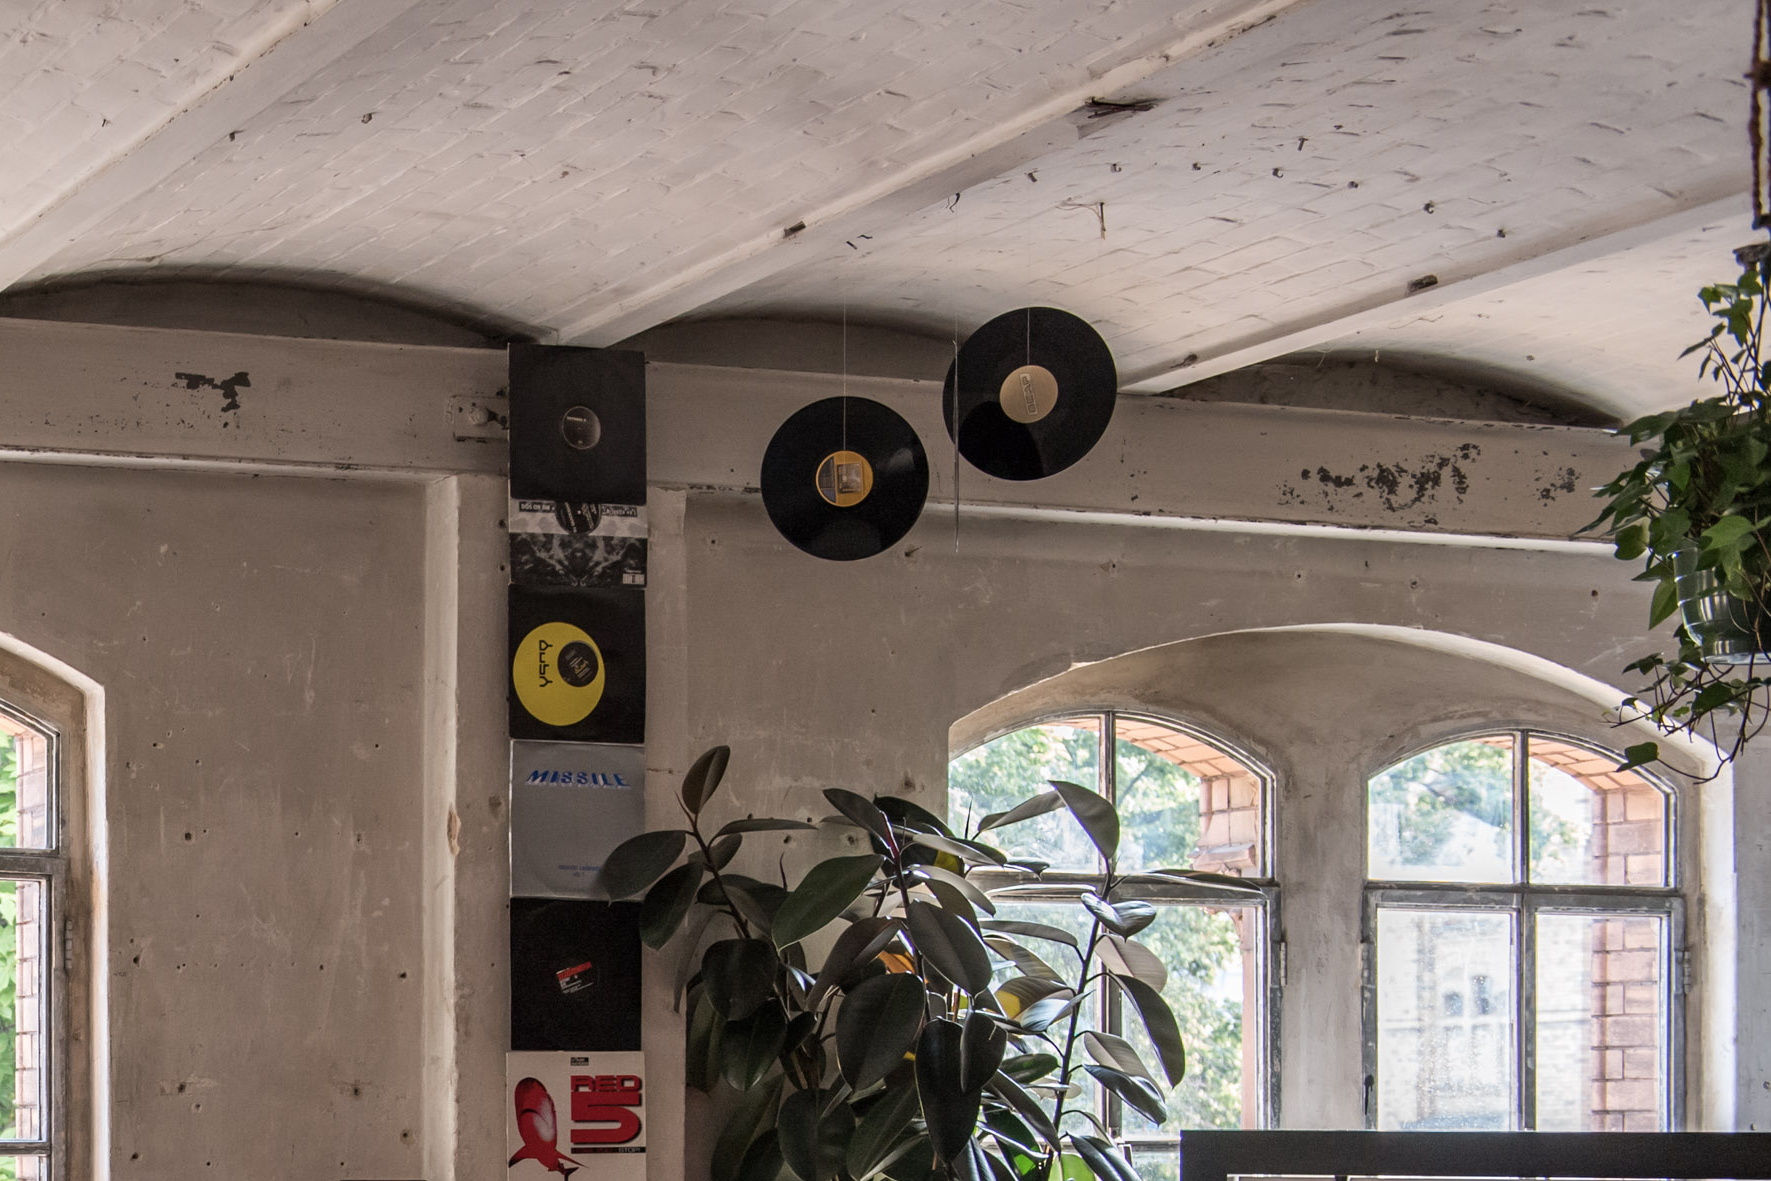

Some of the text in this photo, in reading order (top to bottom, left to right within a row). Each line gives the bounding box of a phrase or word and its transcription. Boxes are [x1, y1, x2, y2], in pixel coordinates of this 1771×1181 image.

[526, 770, 631, 788] MISSILE
[571, 1074, 642, 1092] RED
[571, 1091, 642, 1145] 5
